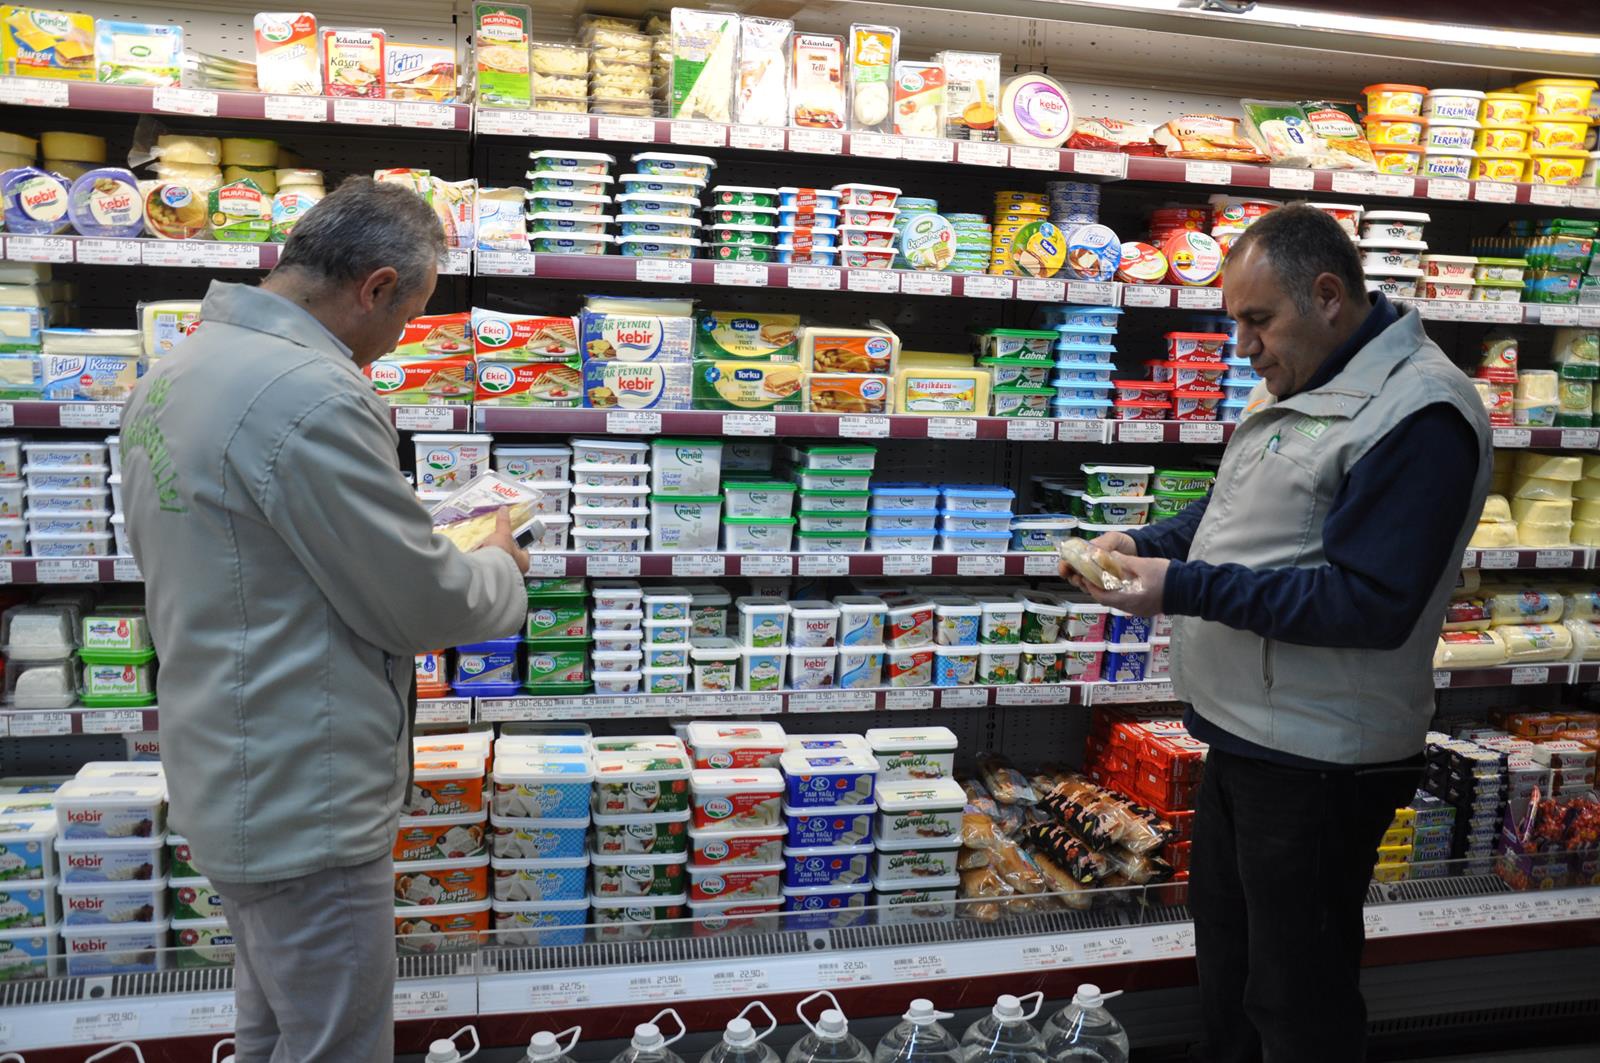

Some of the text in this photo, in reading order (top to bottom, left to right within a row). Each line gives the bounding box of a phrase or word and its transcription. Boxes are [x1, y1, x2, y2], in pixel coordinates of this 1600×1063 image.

[483, 17, 520, 27] MURATBEY
[17, 47, 53, 63] Burger
[1039, 99, 1063, 112] kebir
[24, 187, 58, 206] kebir
[98, 195, 131, 210] kebir
[516, 324, 531, 332] Taze
[733, 319, 757, 330] Torku
[482, 325, 505, 336] Ekici
[513, 331, 532, 339] Kaşar
[616, 329, 654, 345] kebir
[1019, 350, 1047, 361] Labne
[89, 357, 127, 373] Kaşar
[374, 371, 398, 380] Ekici
[485, 371, 508, 381] Ekici
[518, 369, 533, 377] Taze
[736, 370, 761, 380] Torku
[516, 375, 534, 383] Kaşar
[618, 377, 655, 391] kebir
[1016, 379, 1043, 389] Labne
[1017, 407, 1044, 417] Labne
[459, 446, 478, 454] Süzme
[431, 454, 450, 462] Ekici
[459, 452, 478, 461] Peynir
[510, 463, 524, 471] Ekici
[490, 482, 521, 499] kebir
[760, 588, 783, 598] kebir
[806, 620, 831, 632] kebir
[803, 658, 828, 669] kebir
[134, 741, 160, 752] kebi
[713, 756, 729, 764] Ekici
[885, 754, 928, 772] Sürmeli
[817, 790, 836, 798] YAĞLI
[431, 799, 462, 815] Beyaz
[710, 803, 727, 811] Ekici
[67, 809, 103, 823] kebir
[892, 813, 936, 831] Sürmeli
[815, 831, 833, 839] YAĞLI
[402, 845, 432, 859] Beyaz
[708, 846, 725, 854] Ekici
[68, 854, 104, 868] kebir
[887, 853, 931, 871] Sürmeli
[813, 870, 831, 878] YAĞLI
[704, 880, 721, 889] Ekici
[440, 887, 469, 902] Beyaz
[69, 896, 104, 911] kebir
[72, 939, 107, 953] kebir
